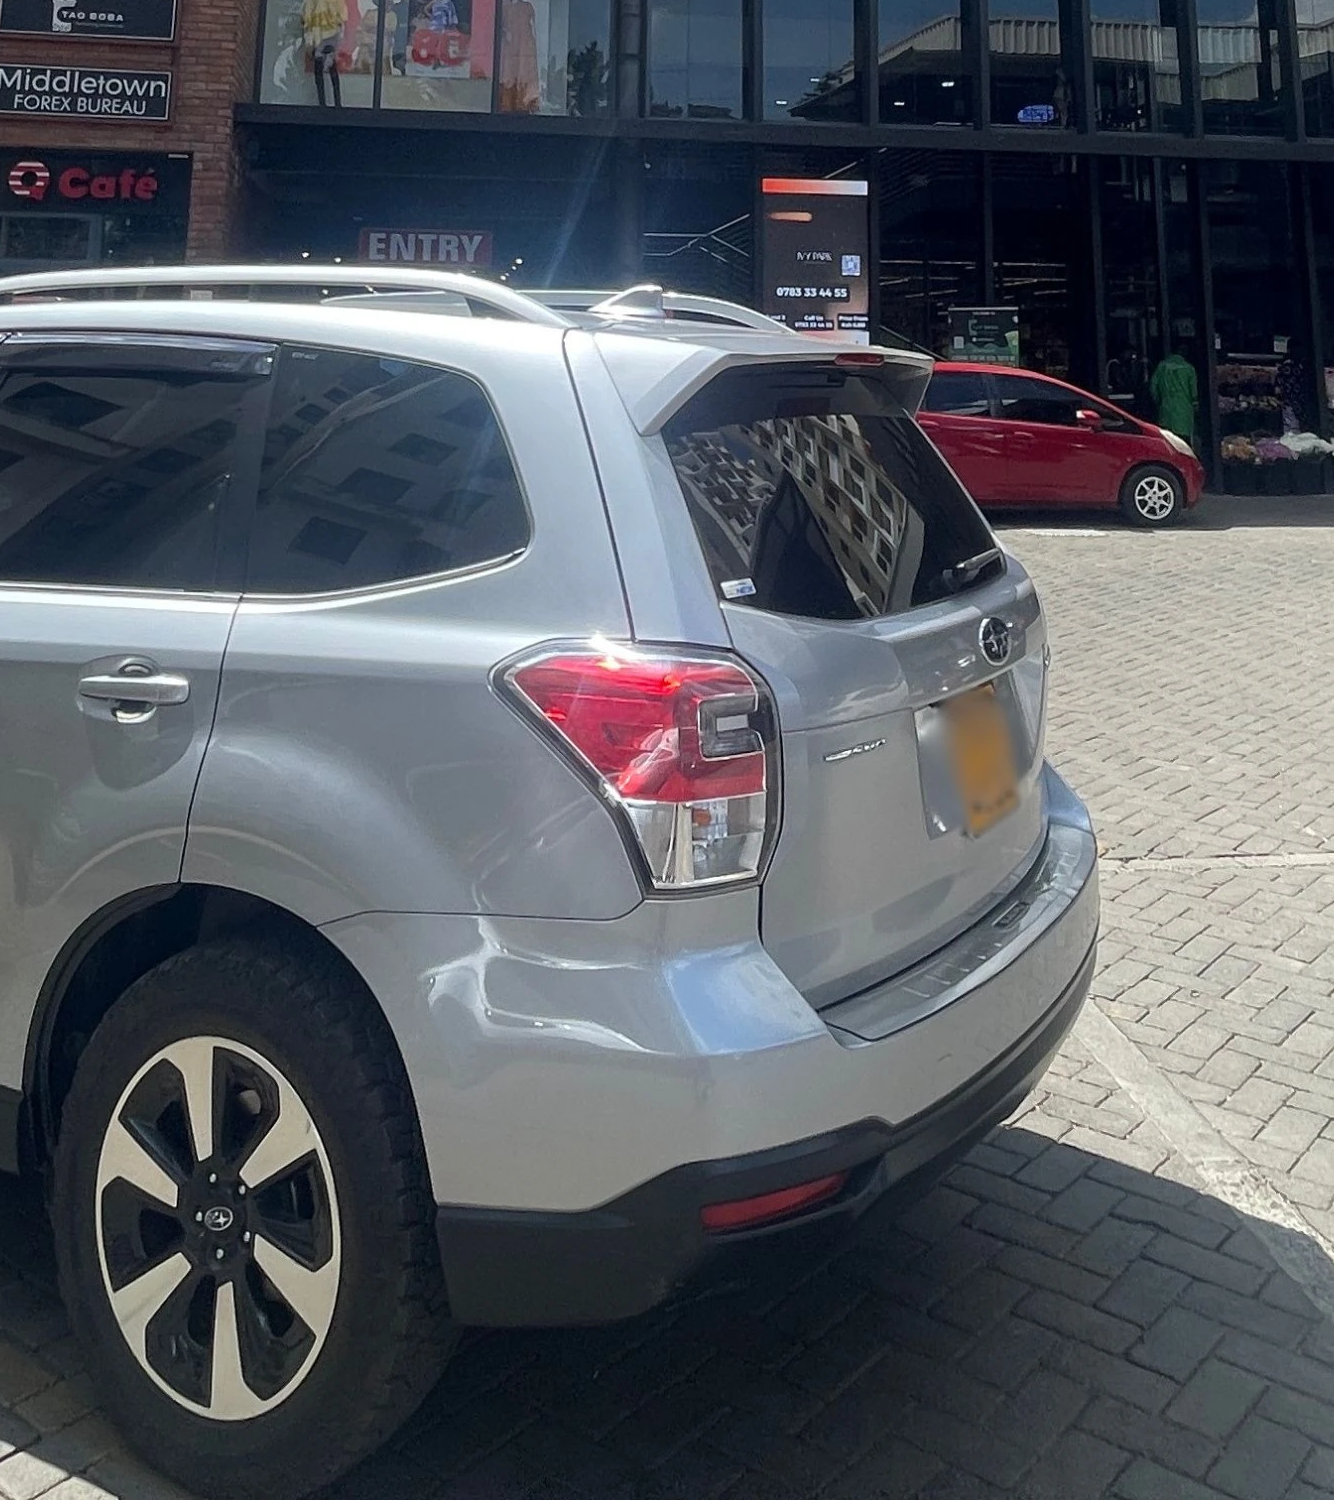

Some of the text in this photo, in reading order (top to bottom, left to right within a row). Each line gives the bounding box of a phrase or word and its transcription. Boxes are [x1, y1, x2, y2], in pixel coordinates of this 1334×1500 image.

[61, 10, 124, 22] TAO BOBA
[13, 93, 147, 115] FOREX BUREAU
[58, 167, 158, 200] Café
[369, 233, 483, 262] ENTRY
[803, 287, 818, 297] 33
[818, 288, 833, 297] 44
[834, 288, 848, 298] 55
